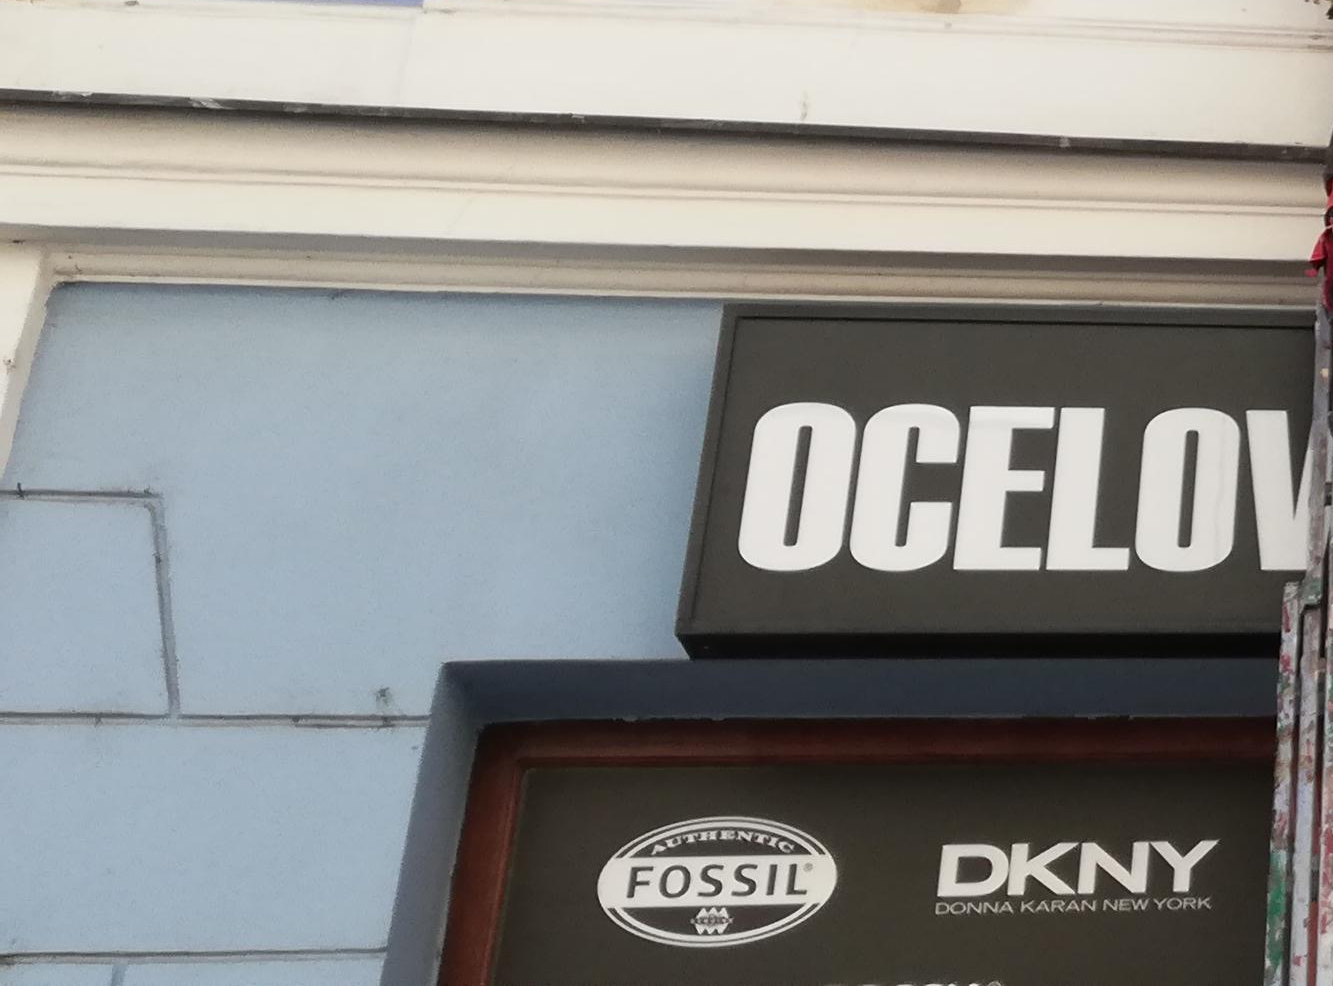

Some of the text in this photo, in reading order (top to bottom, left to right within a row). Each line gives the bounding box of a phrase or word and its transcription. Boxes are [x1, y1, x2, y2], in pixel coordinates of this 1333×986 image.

[738, 402, 1320, 572] OCELOV
[650, 829, 796, 856] AUTHENTIC
[626, 863, 808, 899] FOSSIL
[937, 839, 1221, 897] DKNY
[935, 896, 1212, 915] DONNA KARAN NEW YORK
